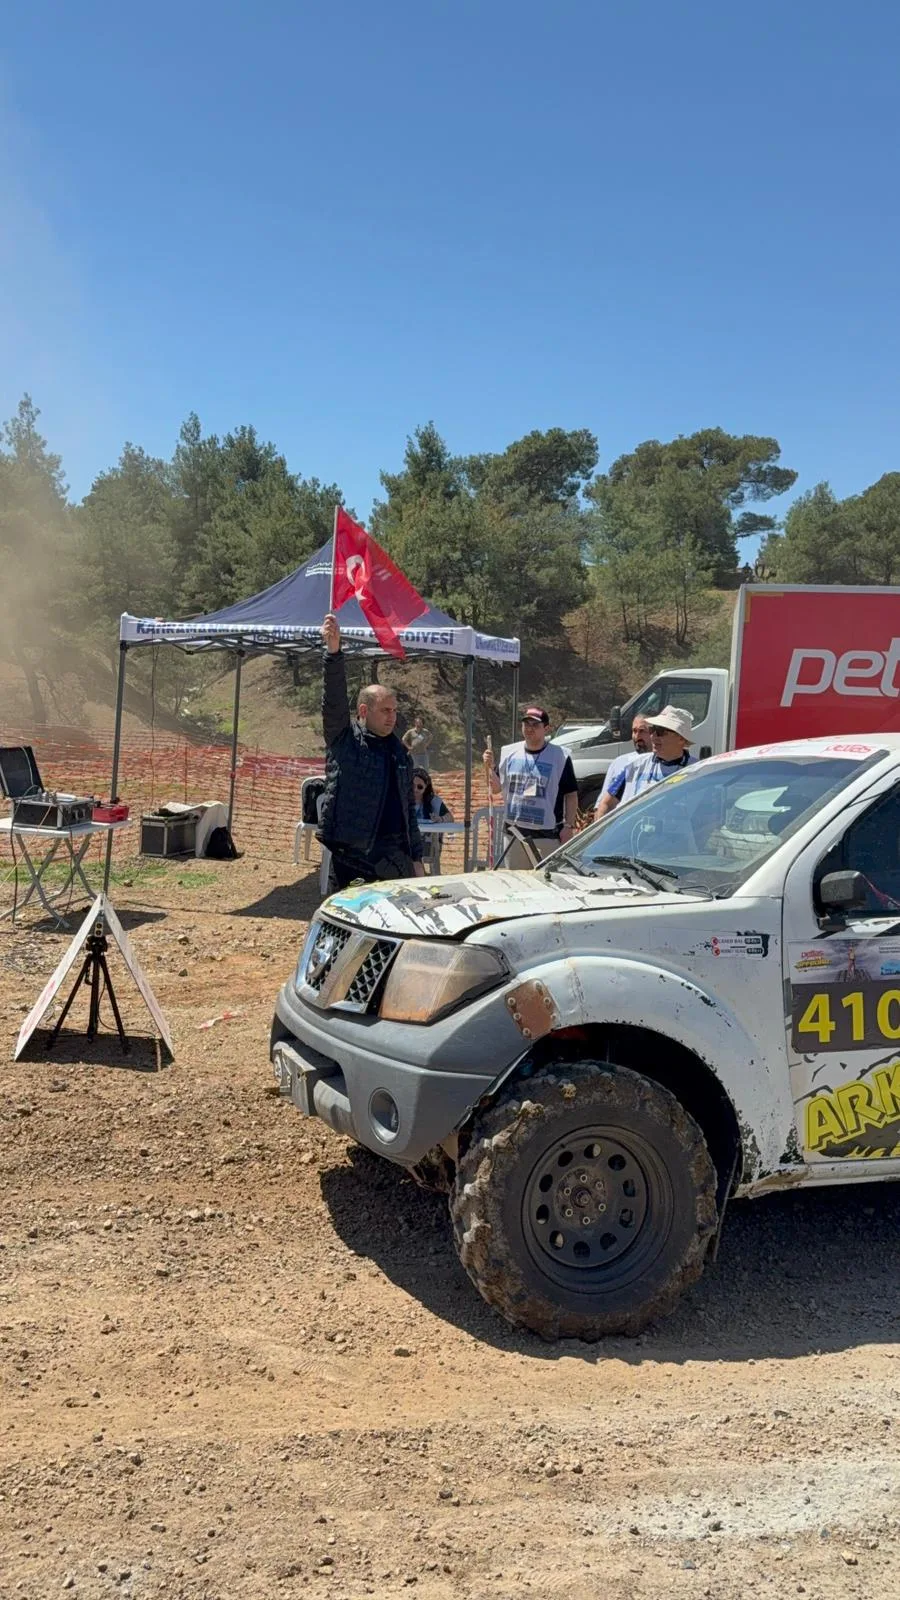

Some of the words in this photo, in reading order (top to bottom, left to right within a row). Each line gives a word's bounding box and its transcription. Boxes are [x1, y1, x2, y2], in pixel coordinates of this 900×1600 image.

[780, 637, 900, 707] pet
[798, 989, 900, 1043] 410
[804, 1061, 900, 1151] ARK
